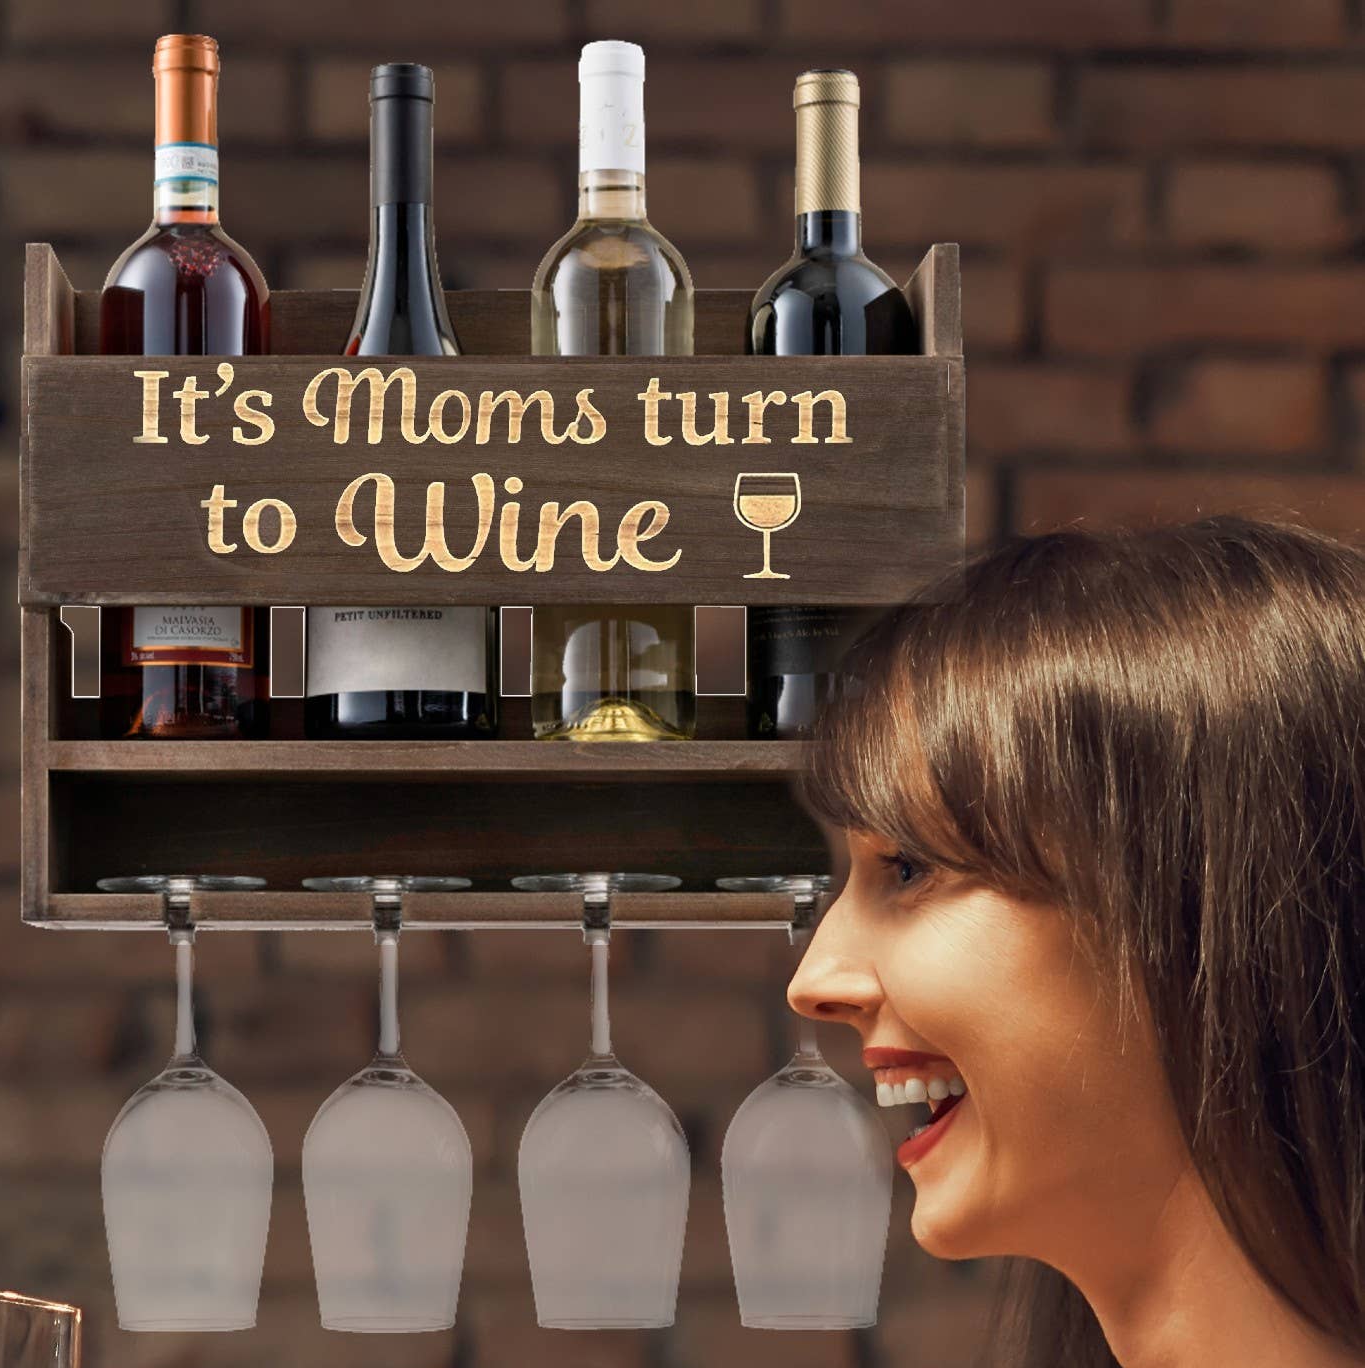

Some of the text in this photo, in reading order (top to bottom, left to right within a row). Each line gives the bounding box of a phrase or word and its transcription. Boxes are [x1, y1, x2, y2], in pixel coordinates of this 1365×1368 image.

[303, 366, 606, 444] Moms
[637, 377, 852, 446] turn
[201, 473, 682, 573] to Wine
[162, 615, 215, 625] MALVASIA
[334, 609, 443, 622] PETIT UNFILTERED
[154, 625, 168, 635] DI
